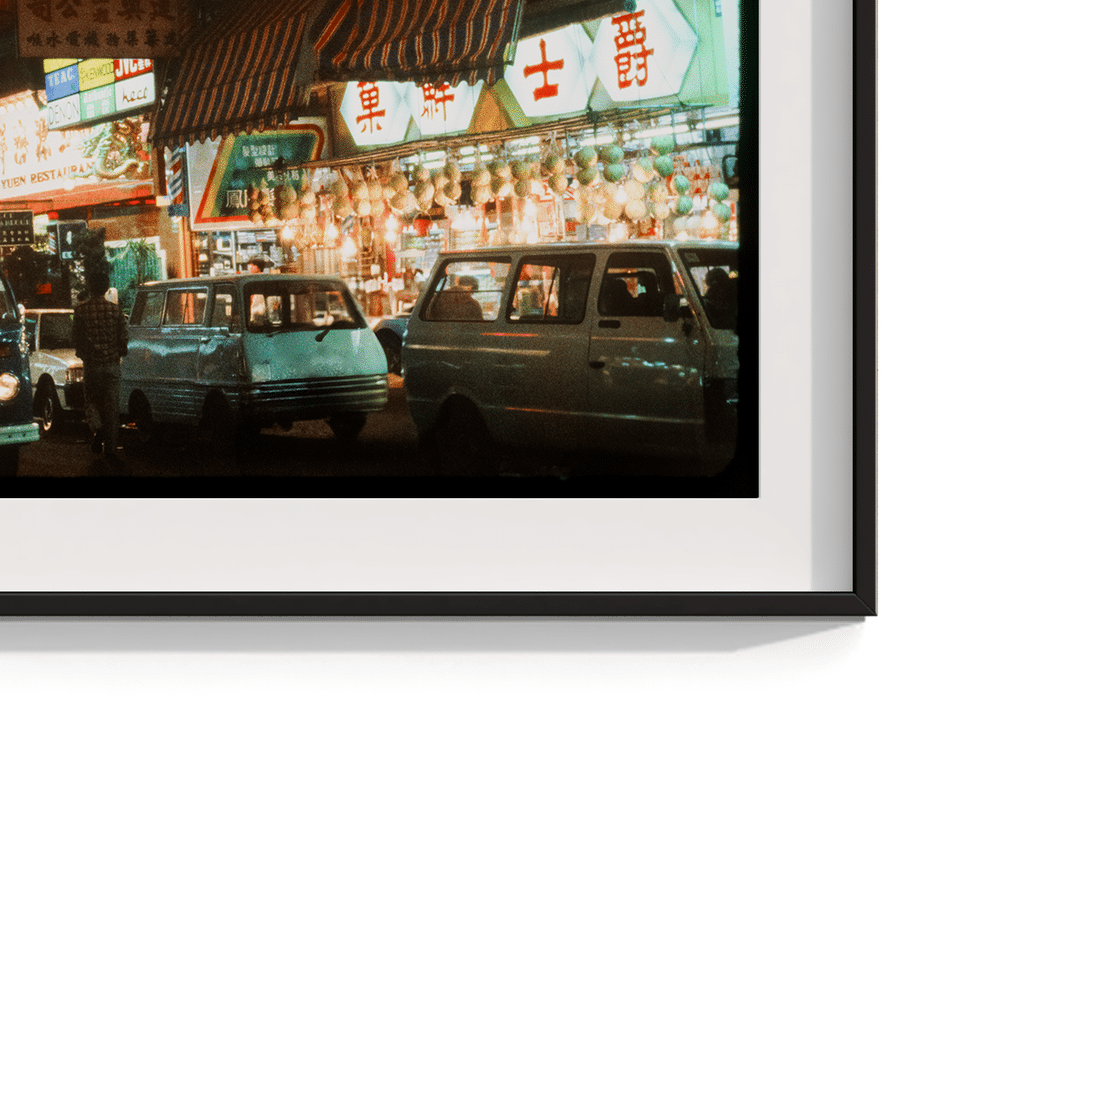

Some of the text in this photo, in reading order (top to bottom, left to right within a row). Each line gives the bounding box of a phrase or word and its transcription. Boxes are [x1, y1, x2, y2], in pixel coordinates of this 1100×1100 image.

[48, 67, 77, 87] TEAC
[49, 101, 81, 126] DENON
[2, 175, 26, 190] YUEN
